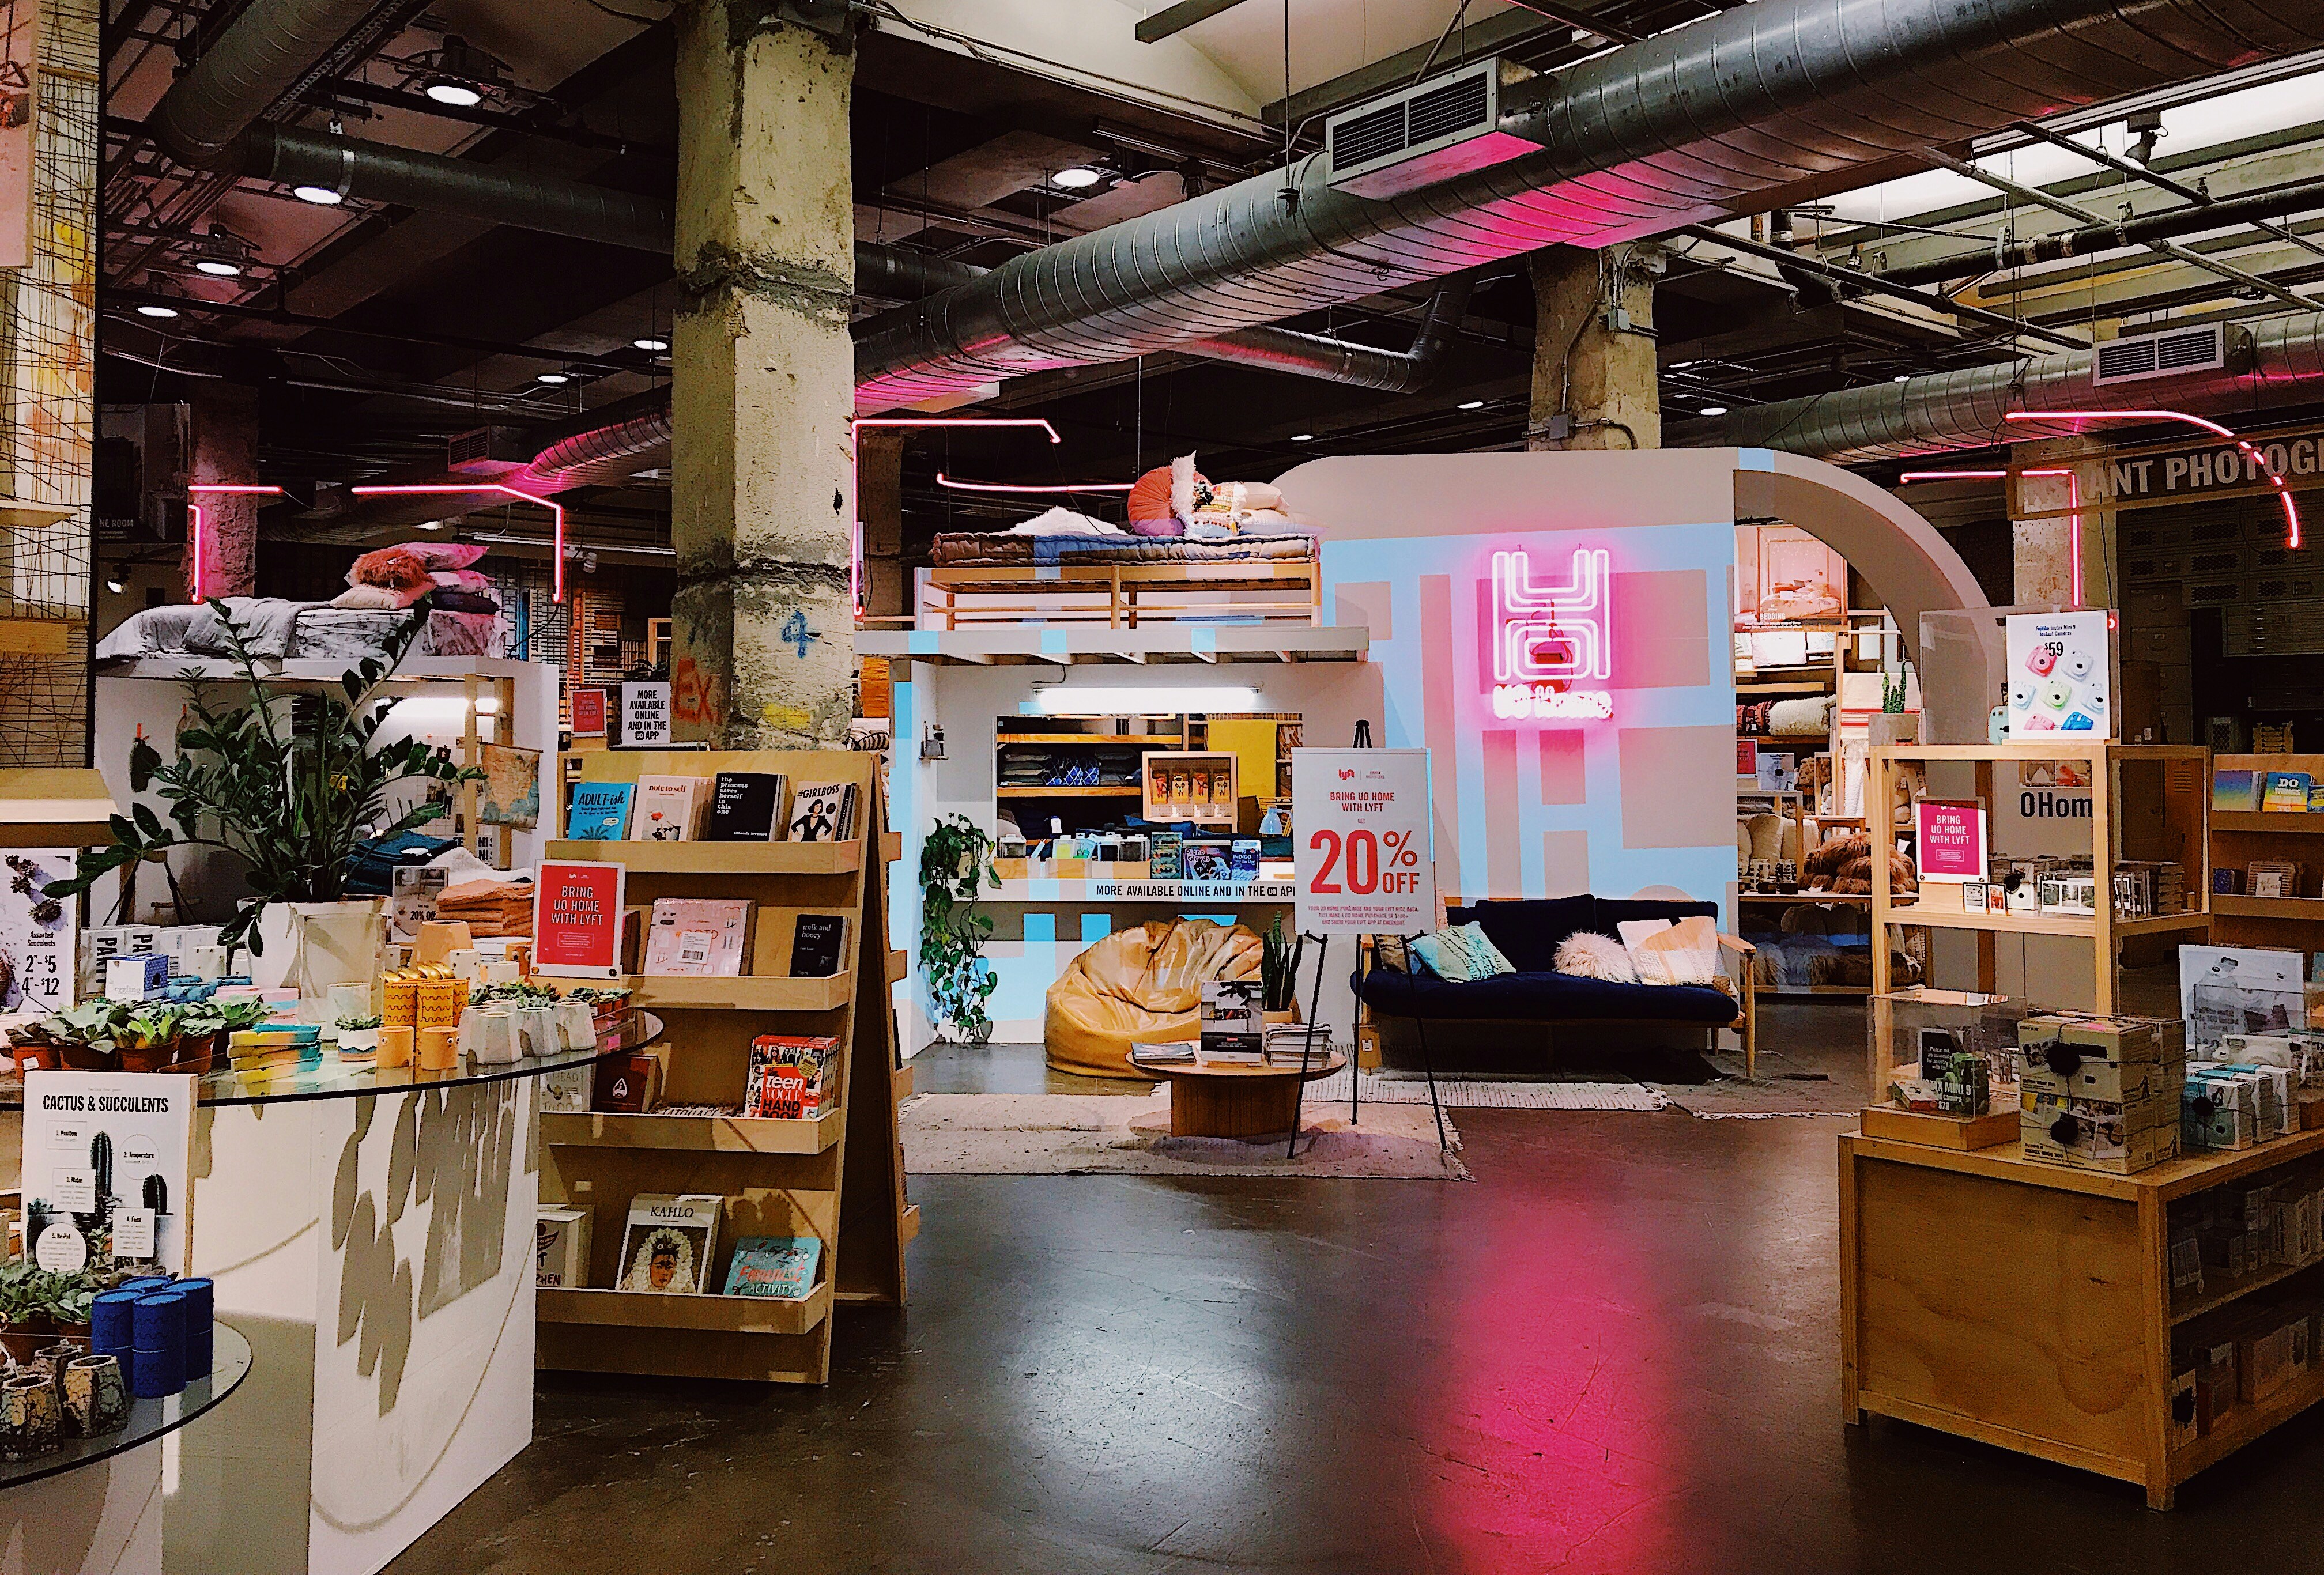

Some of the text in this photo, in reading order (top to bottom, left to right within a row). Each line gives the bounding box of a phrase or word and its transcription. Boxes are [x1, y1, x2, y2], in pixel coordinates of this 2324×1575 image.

[2045, 642, 2063, 656] $59
[637, 690, 657, 699] MORE
[629, 700, 665, 709] AVAILABLE
[635, 711, 659, 719] ONLINE
[628, 721, 666, 730] AND IN THE
[646, 731, 659, 740] APP
[1338, 769, 1355, 780] lyft
[2278, 778, 2299, 787] DO
[797, 784, 840, 799] #GIRLBOSS
[1330, 792, 1394, 801] BRING UO HOME
[578, 791, 625, 806] ADULT-ish
[1342, 803, 1383, 811] WITH LYFT
[1937, 815, 1960, 824] BRING
[1931, 825, 1966, 834] UO HOME
[1930, 835, 1970, 844] WITH LYFT
[1310, 829, 1417, 895] 20%
[1383, 873, 1420, 894] OFF
[561, 886, 593, 898] BRING
[1096, 885, 1122, 896] MORE
[1127, 886, 1174, 896] AVAILABLE
[1177, 886, 1209, 896] ONLINE
[1213, 886, 1231, 896] AND
[1236, 886, 1244, 896] IN
[1247, 886, 1265, 896] THE
[554, 900, 599, 912] UO HOME
[410, 911, 424, 920] 20%
[552, 913, 603, 926] WITH LYFT
[802, 931, 821, 939] honey
[114, 985, 141, 995] eggling
[766, 1076, 803, 1090] teen
[766, 1088, 802, 1101] VOGUE
[43, 1095, 168, 1113] CACTUS & SUCCULENTS
[763, 1099, 800, 1112] HAND
[762, 1111, 799, 1119] BOOK
[650, 1207, 693, 1218] KAHLO
[749, 1284, 794, 1294] ACTIVITY
